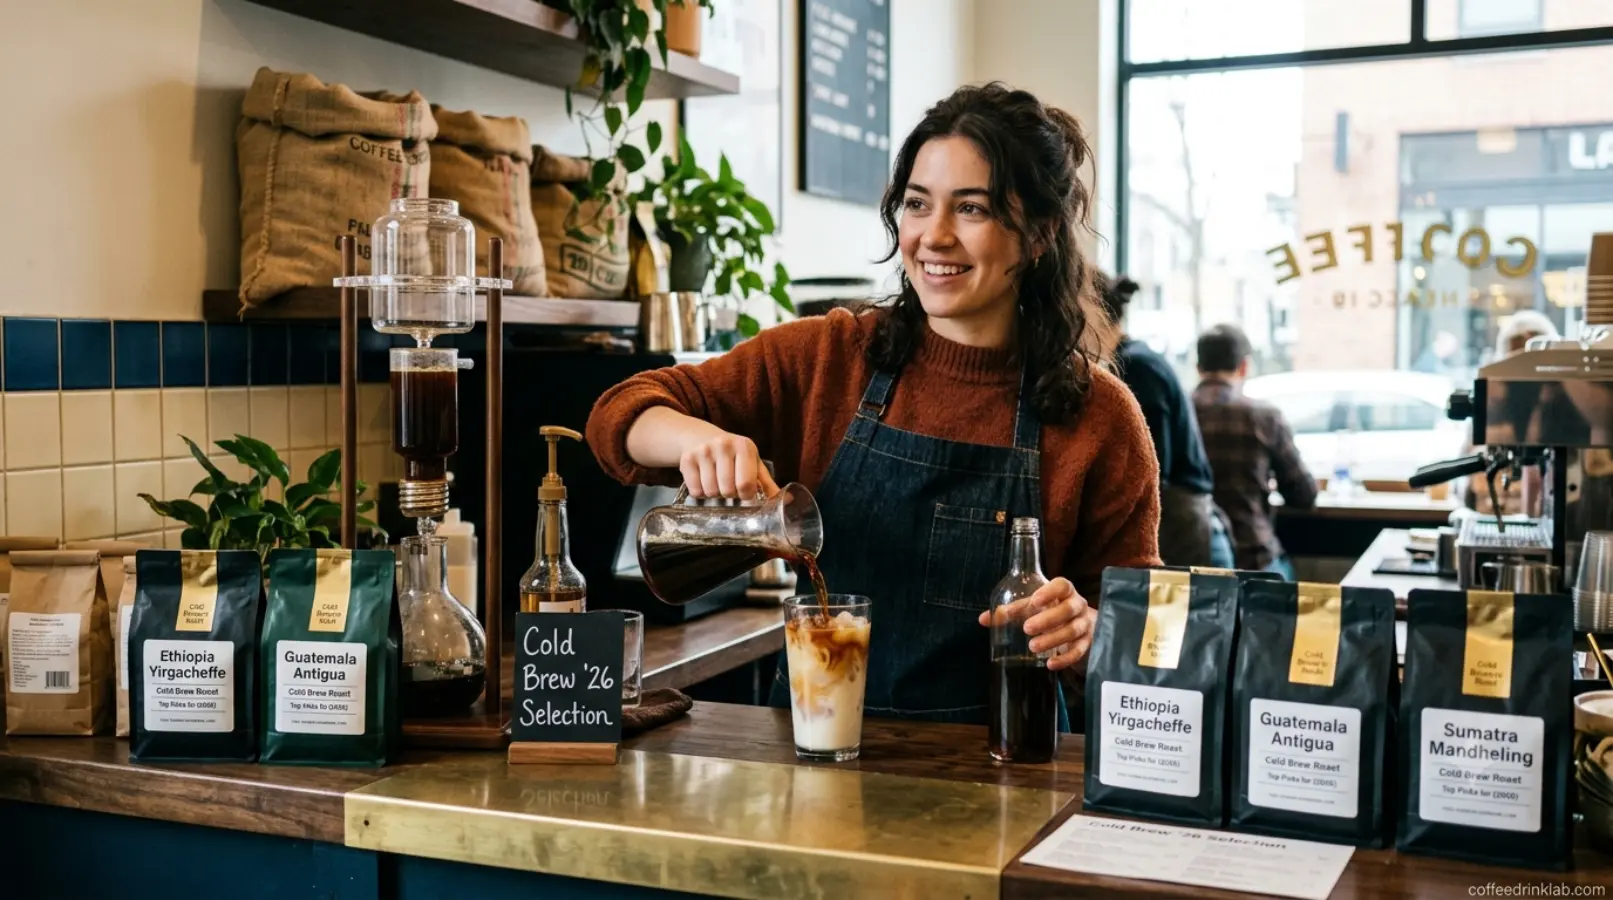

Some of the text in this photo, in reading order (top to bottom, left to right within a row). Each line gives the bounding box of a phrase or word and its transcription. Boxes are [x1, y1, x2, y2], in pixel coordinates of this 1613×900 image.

[523, 626, 576, 656] Cold
[160, 649, 215, 665] Ethiopia
[284, 650, 357, 665] Guatemala
[149, 665, 226, 681] Yirgacheffe
[293, 667, 346, 683] Antigua
[522, 663, 614, 691] Brew '26
[519, 699, 613, 727] Selection
[1120, 695, 1180, 715] Ethiopia
[1108, 711, 1192, 734] Yirgacheffe
[1260, 711, 1347, 734] Guatemala
[1443, 722, 1518, 743] Sumatra
[1271, 731, 1334, 753] Antigua
[1429, 740, 1533, 768] Mandheling
